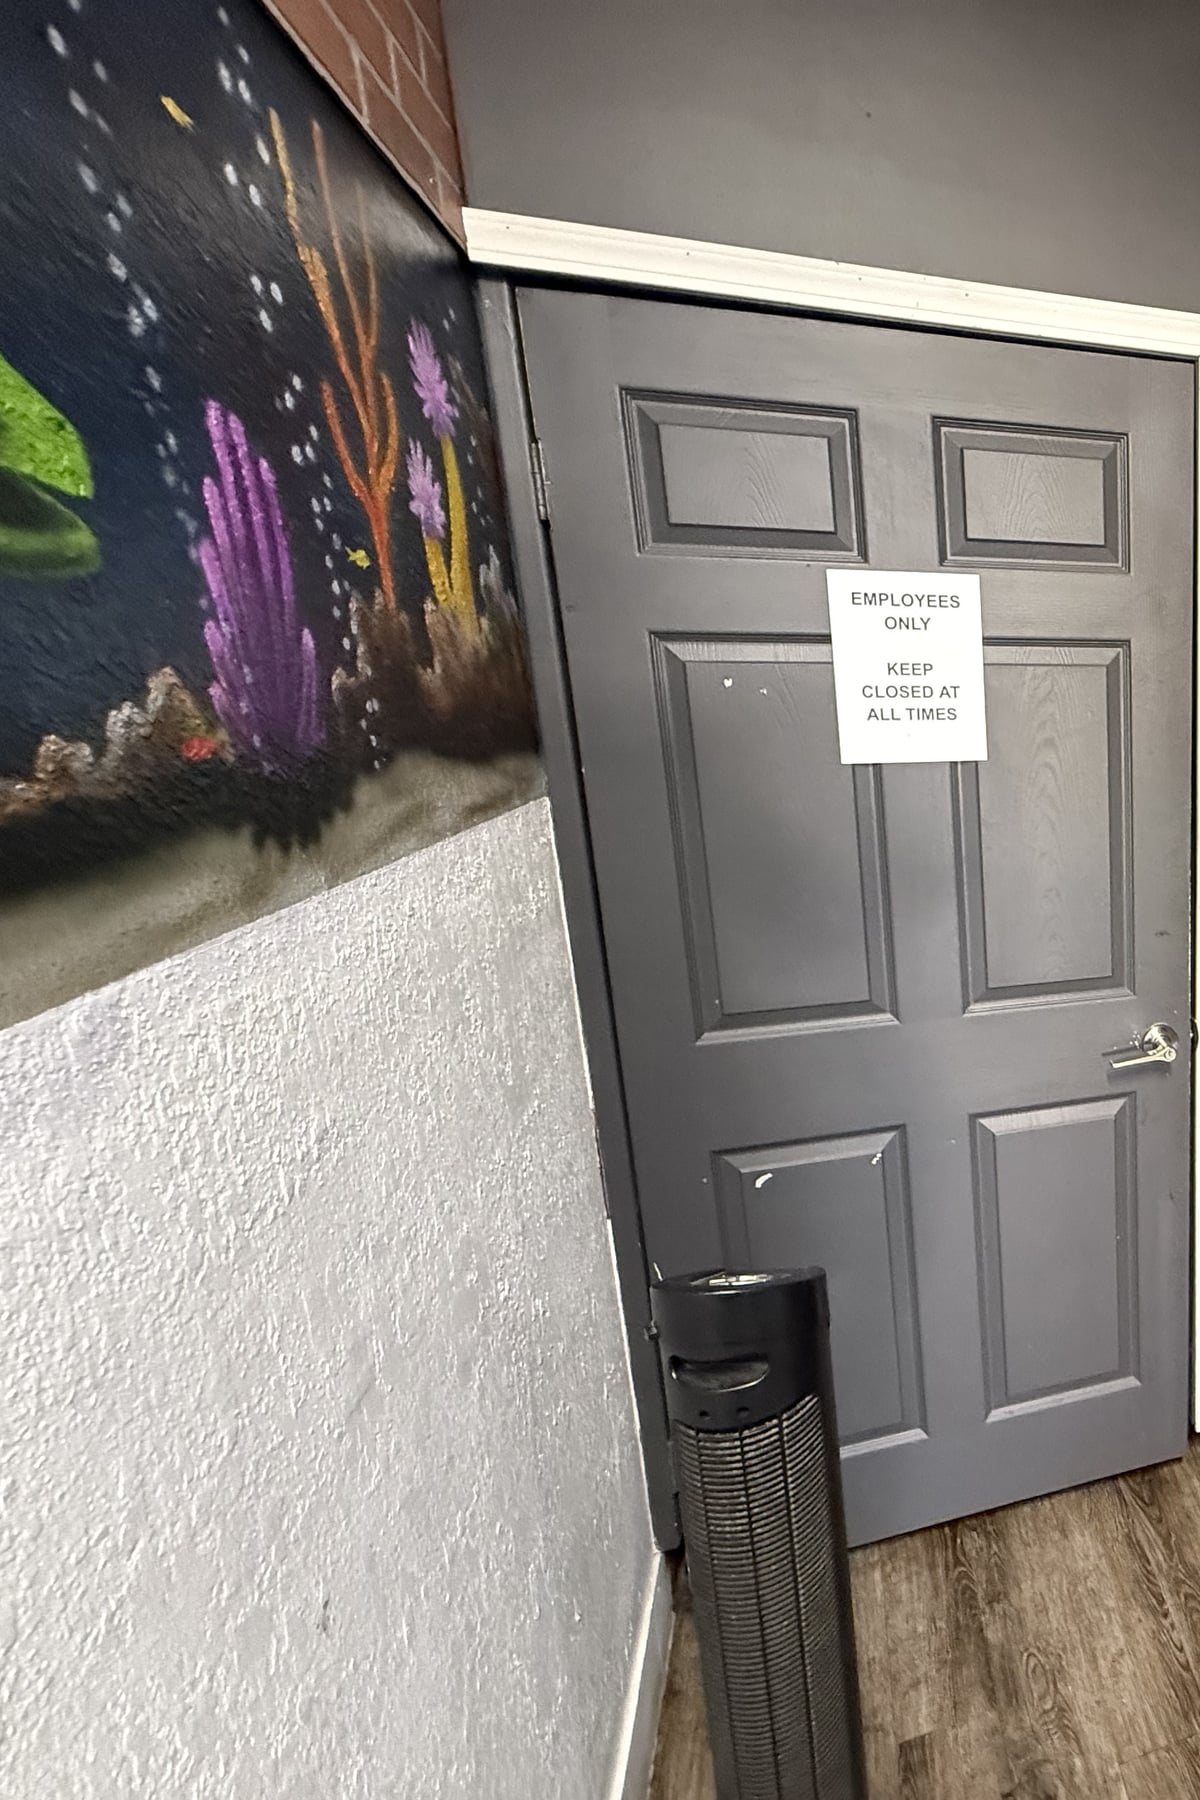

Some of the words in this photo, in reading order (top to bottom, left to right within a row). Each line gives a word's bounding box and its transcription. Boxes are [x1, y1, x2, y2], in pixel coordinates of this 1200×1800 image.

[851, 592, 961, 608] EMPLOYEES
[884, 616, 931, 630] ONLY
[887, 662, 934, 676] KEEP
[861, 685, 934, 699] CLOSED
[939, 685, 961, 699] AT
[866, 707, 901, 721] ALL
[905, 707, 958, 721] TIMES
